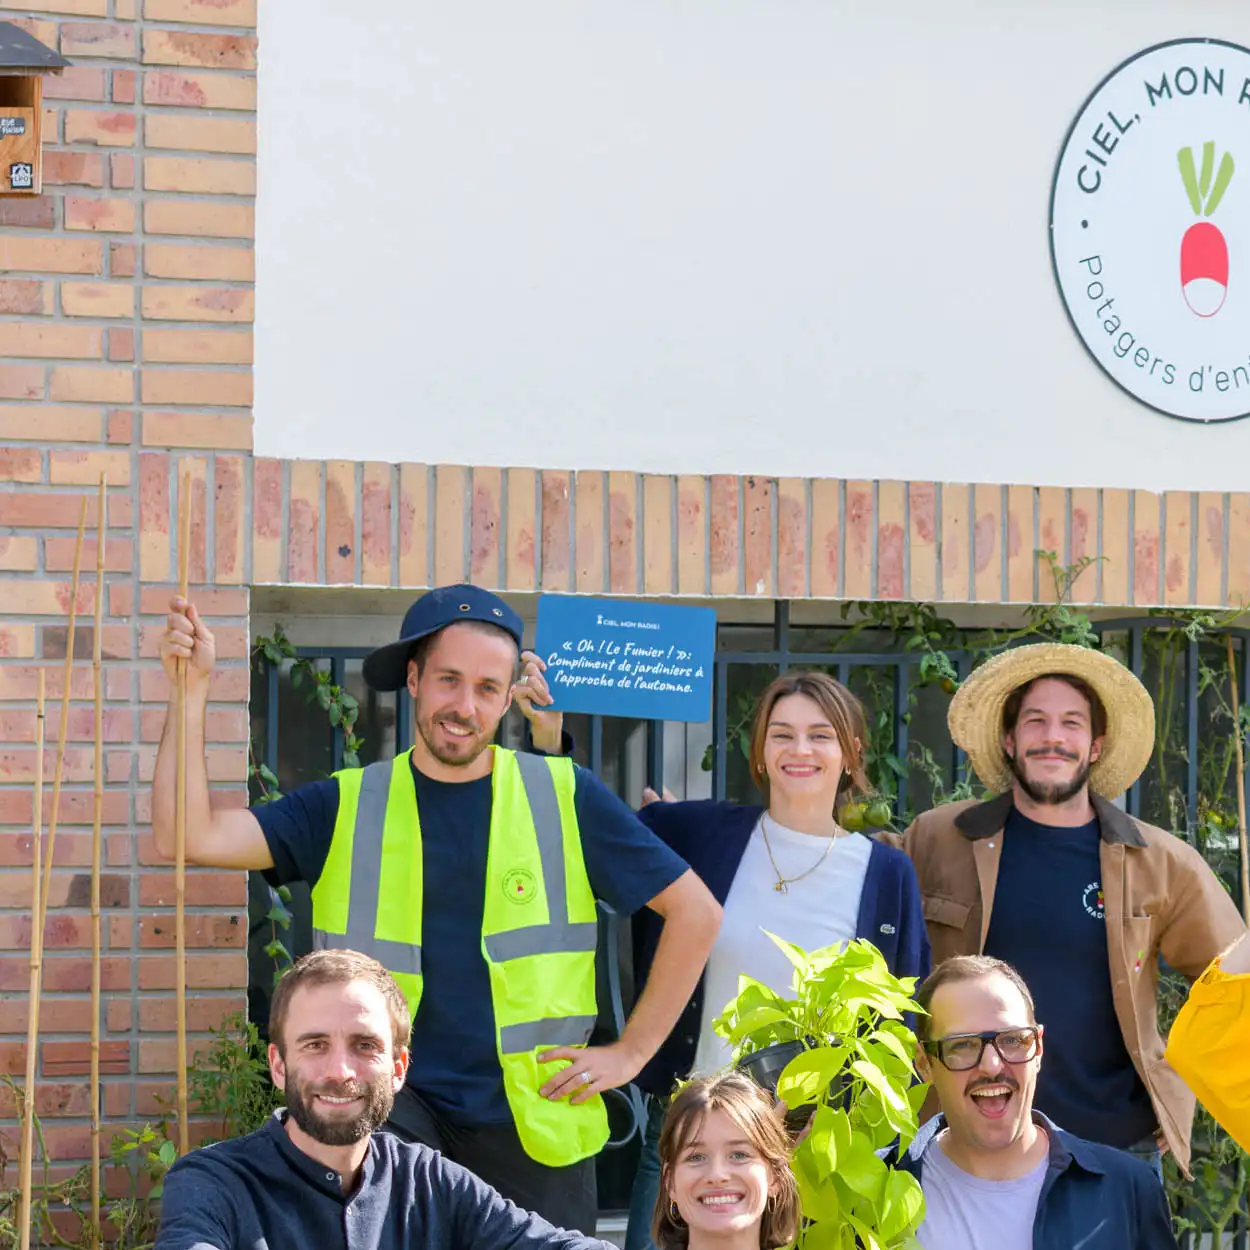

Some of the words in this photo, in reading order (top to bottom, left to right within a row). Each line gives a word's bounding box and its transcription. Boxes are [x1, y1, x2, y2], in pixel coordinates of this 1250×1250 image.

[1077, 111, 1141, 194] CIEL,
[1143, 65, 1225, 107] MON
[1079, 254, 1176, 386] Potagers
[577, 639, 594, 652] Oh
[606, 640, 620, 655] Le
[624, 642, 664, 658] Fumier
[547, 652, 616, 671] Compliment
[618, 658, 632, 672] de
[630, 660, 693, 677] jardiniers
[554, 669, 614, 688] l'approche
[617, 676, 632, 688] de
[634, 676, 693, 693] l'automne.
